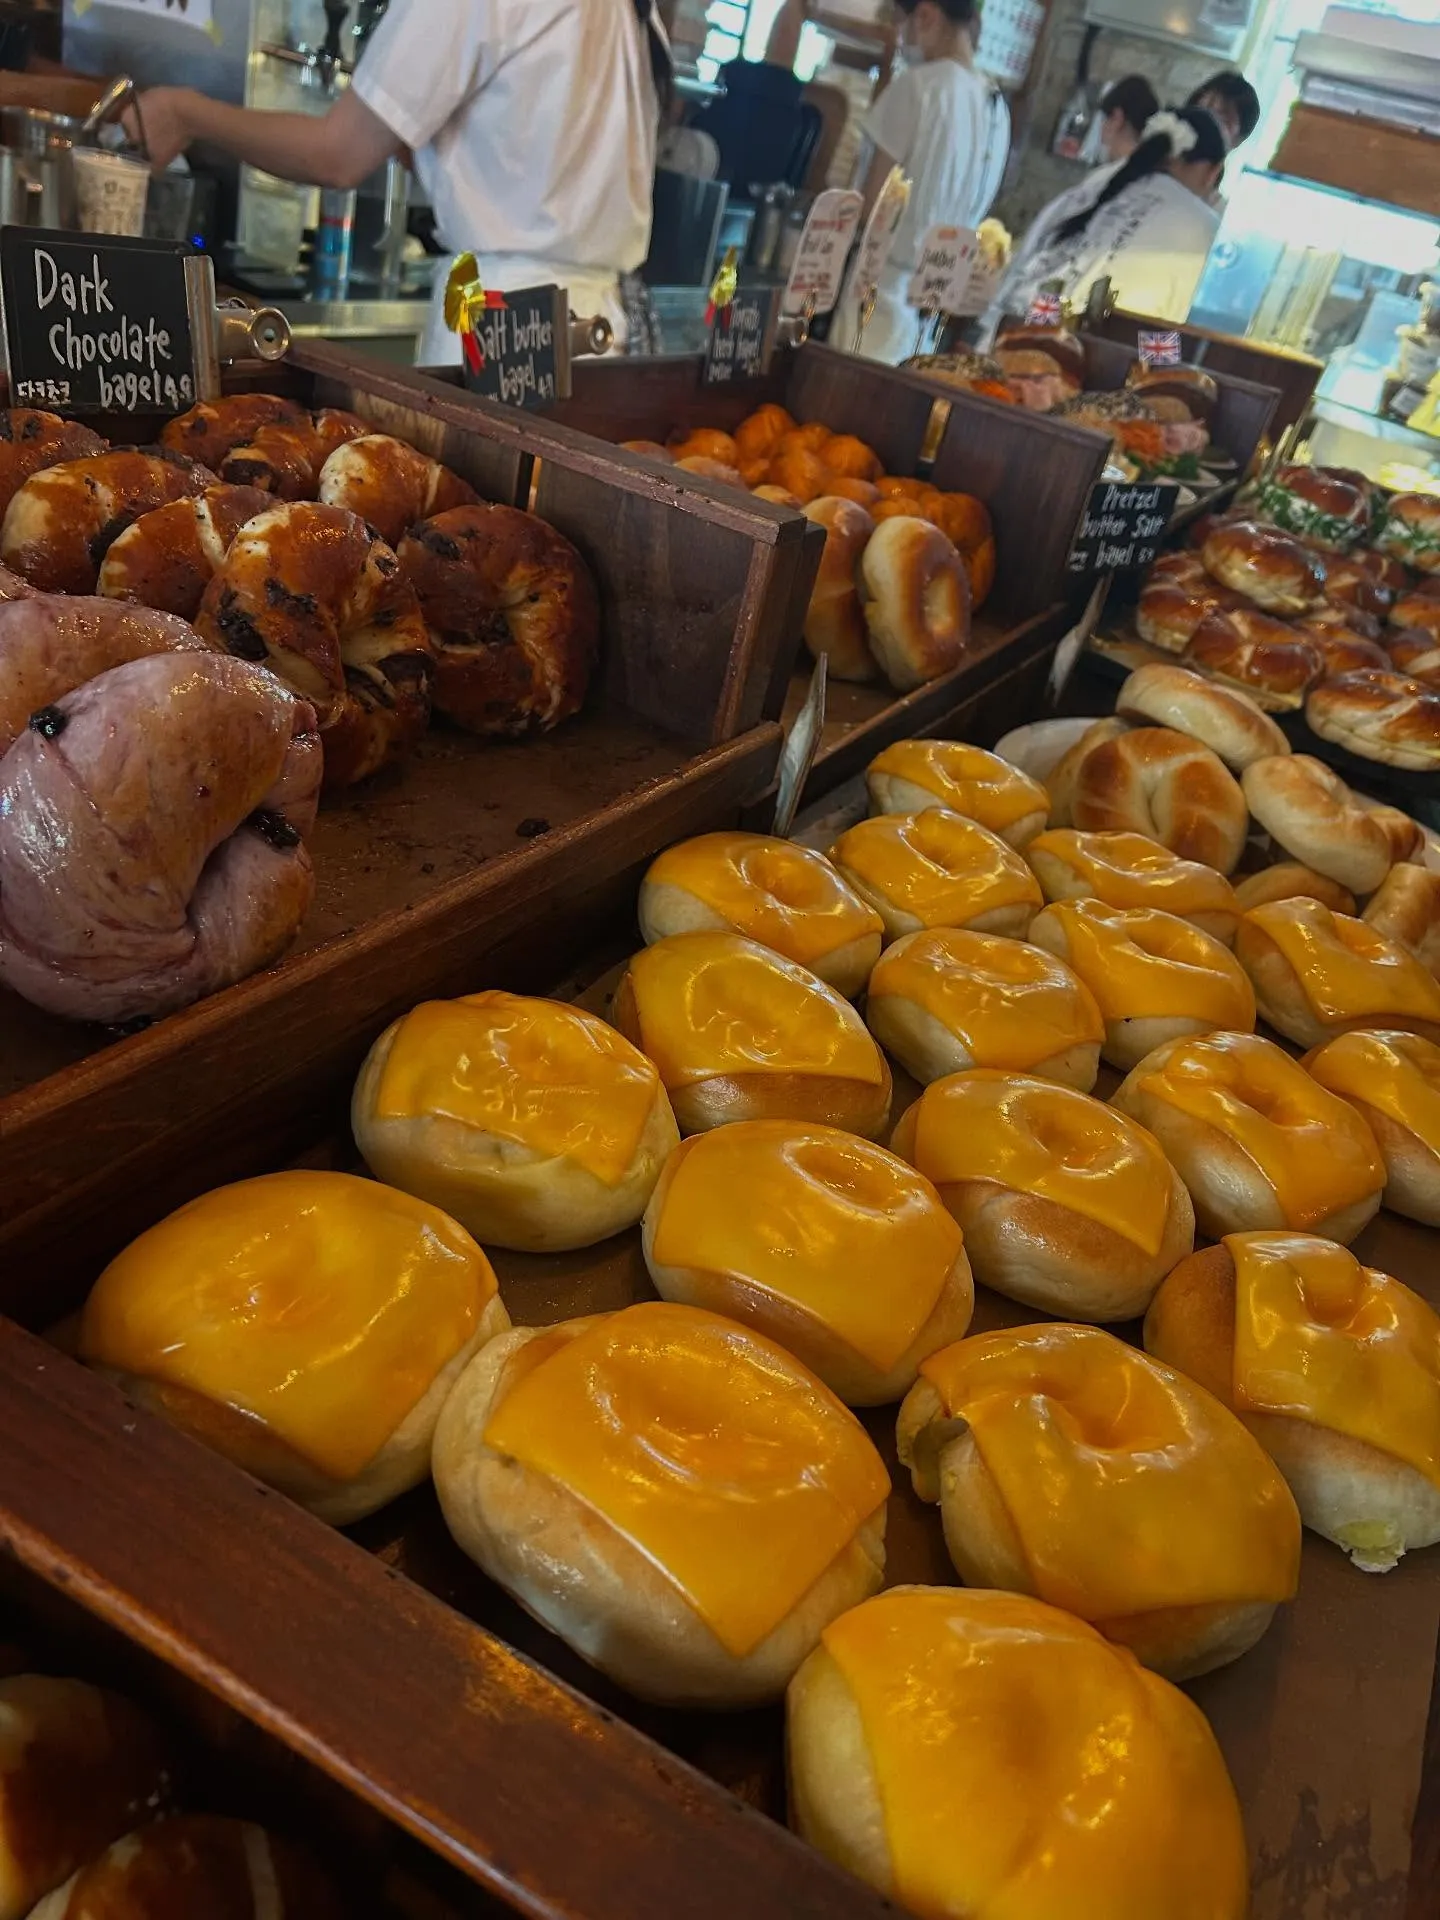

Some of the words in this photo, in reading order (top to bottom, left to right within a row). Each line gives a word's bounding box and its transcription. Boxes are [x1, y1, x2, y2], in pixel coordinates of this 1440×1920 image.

[34, 248, 114, 315] Dark
[98, 364, 161, 411] bagel
[498, 353, 536, 407] bagel
[1101, 484, 1160, 511] Pretzel
